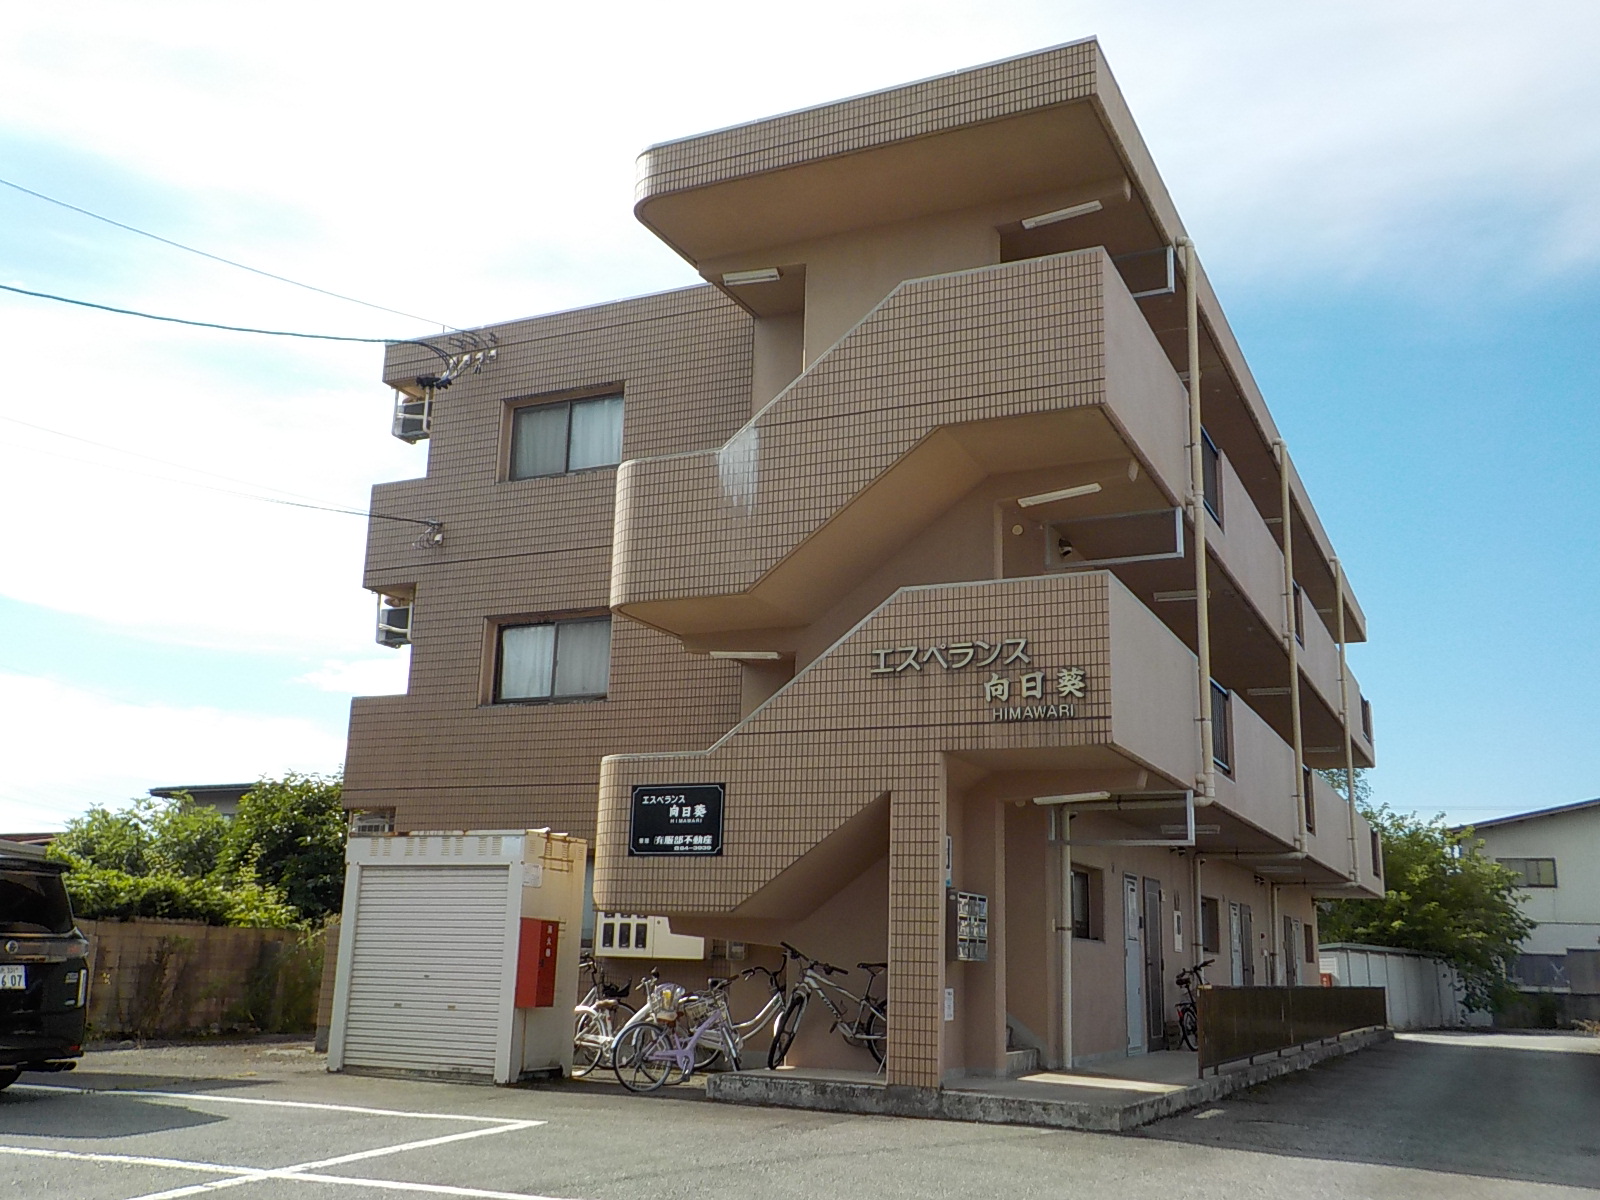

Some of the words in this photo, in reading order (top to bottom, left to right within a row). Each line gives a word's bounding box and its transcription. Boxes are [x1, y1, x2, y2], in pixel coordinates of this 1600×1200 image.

[870, 637, 1031, 673] エスペランス
[983, 667, 1087, 702] 向日葵
[992, 704, 1075, 720] HIMAWARI
[642, 795, 686, 804] エスペランス
[669, 804, 707, 817] 向日葵
